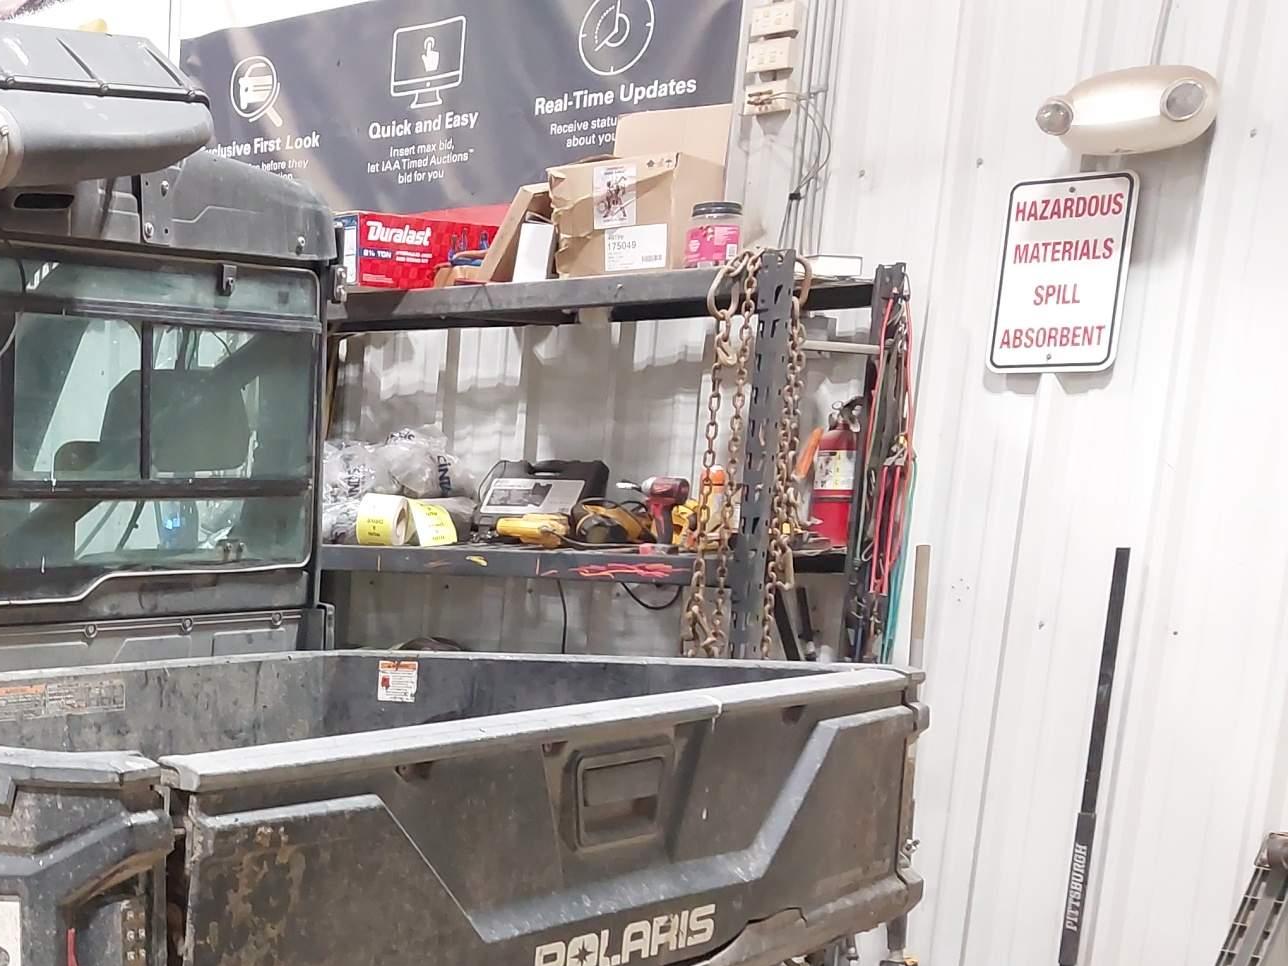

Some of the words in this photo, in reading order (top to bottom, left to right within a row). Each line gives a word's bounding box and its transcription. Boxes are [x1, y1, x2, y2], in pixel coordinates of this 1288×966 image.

[534, 89, 614, 115] Real-Time
[619, 79, 697, 104] Updates
[369, 120, 411, 138] Quick
[415, 115, 441, 133] and
[445, 112, 478, 128] Easy
[550, 119, 588, 135] Receive
[591, 116, 617, 129] statu
[254, 137, 281, 154] First
[286, 131, 320, 149] Look
[390, 146, 415, 157] Insert
[417, 143, 436, 153] max
[439, 138, 454, 151] bid,
[566, 134, 596, 148] about
[261, 160, 286, 171] before
[288, 159, 308, 169] they
[367, 162, 379, 173] let
[381, 159, 400, 172] IAA
[401, 156, 428, 169] Timed
[398, 172, 412, 184] bid
[414, 170, 426, 182] for
[428, 169, 444, 181] you
[1014, 193, 1124, 222] HAZARDOUS
[366, 221, 432, 246] Duralast
[607, 240, 637, 251] 175049
[1013, 237, 1114, 264] MATERIALS
[1033, 284, 1081, 306] SPILL
[999, 325, 1106, 350] ABSORBENT
[1065, 842, 1088, 932] PITTSBURGH
